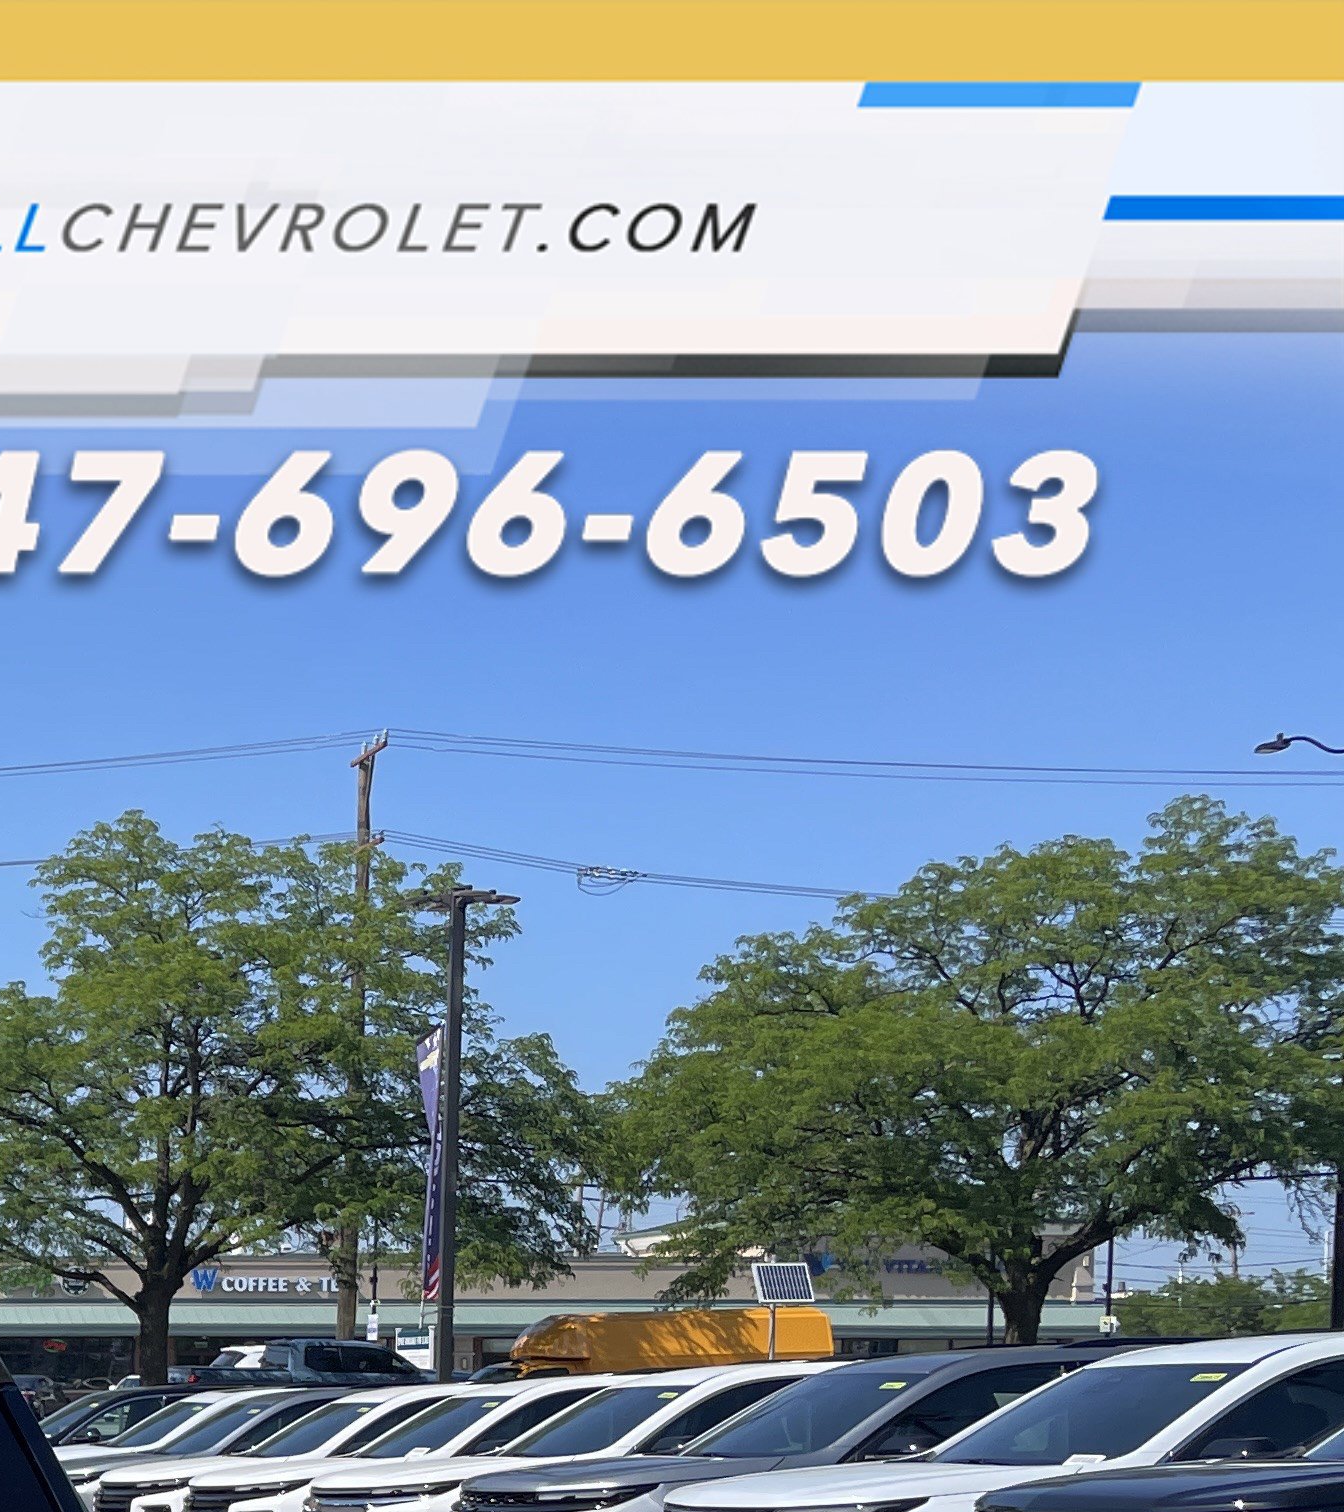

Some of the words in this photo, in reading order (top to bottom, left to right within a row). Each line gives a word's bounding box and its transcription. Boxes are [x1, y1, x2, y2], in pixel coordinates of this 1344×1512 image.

[221, 1276, 288, 1293] COFFEE
[295, 1276, 312, 1293] &
[319, 1277, 340, 1292] TE
